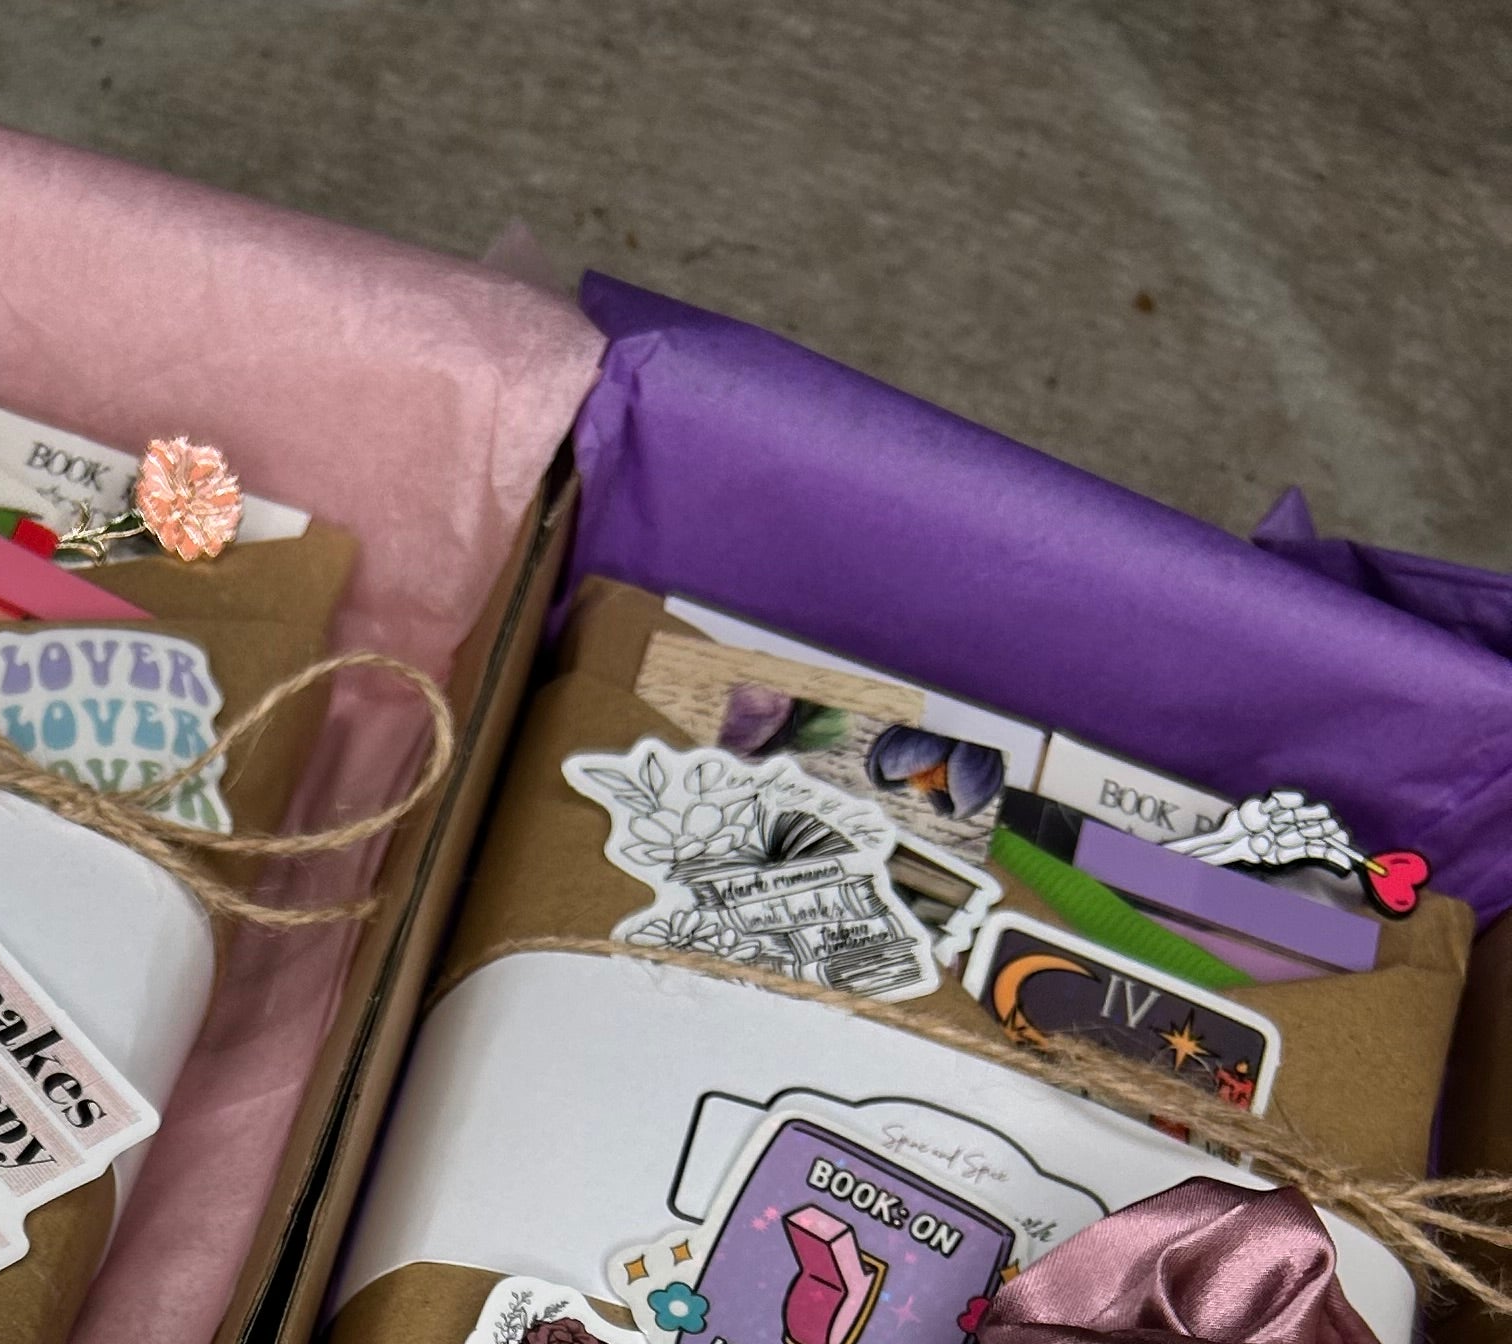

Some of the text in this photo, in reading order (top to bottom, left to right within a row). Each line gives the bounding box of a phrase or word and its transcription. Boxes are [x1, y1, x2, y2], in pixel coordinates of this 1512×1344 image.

[28, 442, 111, 492] BOOK
[0, 640, 210, 707] LOVER
[2, 698, 209, 760] LOVER
[48, 758, 220, 832] OVER
[1098, 778, 1184, 831] BOOK
[1099, 973, 1161, 1030] IV
[807, 1157, 965, 1260] BOOK: ON
